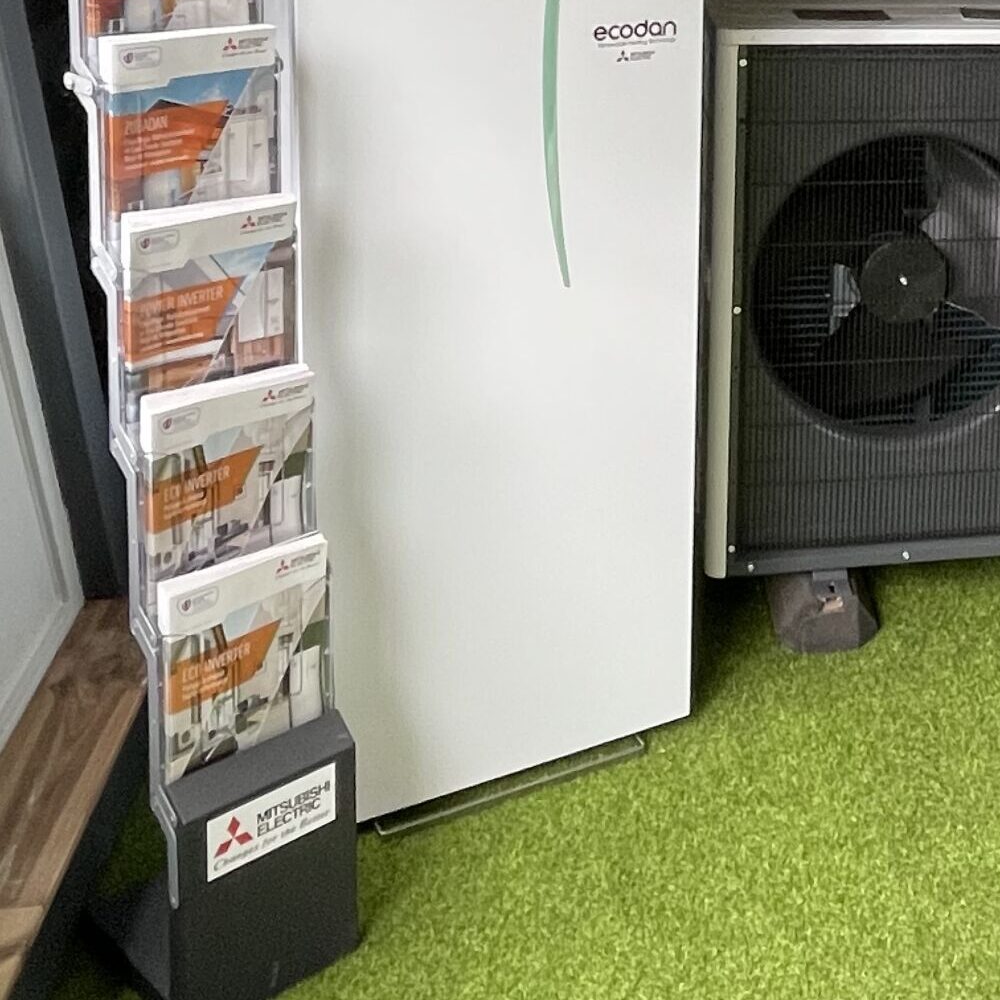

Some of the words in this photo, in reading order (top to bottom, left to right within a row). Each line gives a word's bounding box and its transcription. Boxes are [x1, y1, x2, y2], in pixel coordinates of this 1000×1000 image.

[593, 20, 677, 41] ecodan
[257, 780, 331, 824] MITSUBISHI
[257, 797, 321, 838] ELECTRIC
